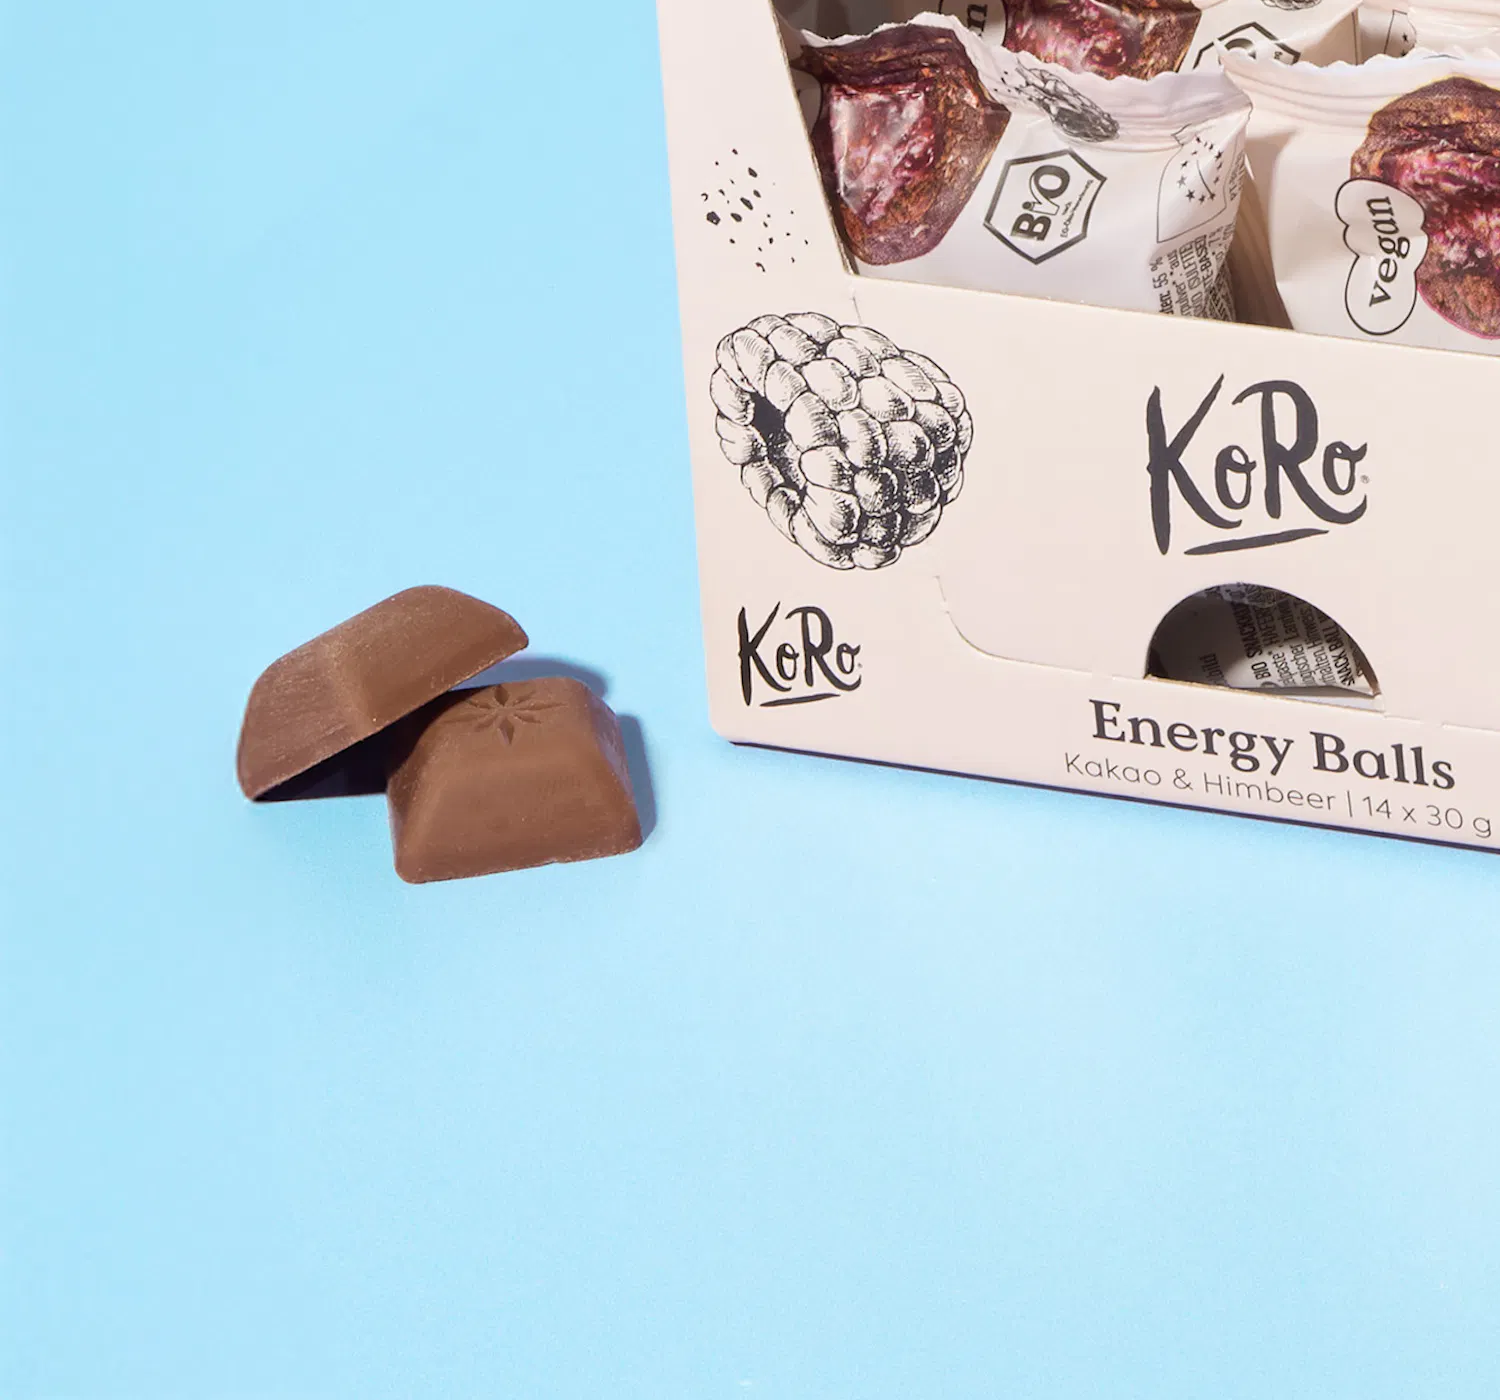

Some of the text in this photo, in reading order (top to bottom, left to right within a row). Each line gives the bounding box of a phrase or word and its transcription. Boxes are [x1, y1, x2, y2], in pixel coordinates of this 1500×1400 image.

[1366, 196, 1410, 307] vegan
[1146, 373, 1367, 555] KoRo
[738, 601, 861, 706] KoRo
[1250, 660, 1271, 681] BIO
[1089, 699, 1456, 790] Energy Balls
[1064, 752, 1161, 786] Kakao
[1172, 768, 1193, 790] &
[1204, 772, 1336, 810] Himbeer
[1362, 795, 1391, 820] 14
[1402, 806, 1417, 823] x
[1426, 804, 1463, 829] 30
[1473, 816, 1491, 838] g
